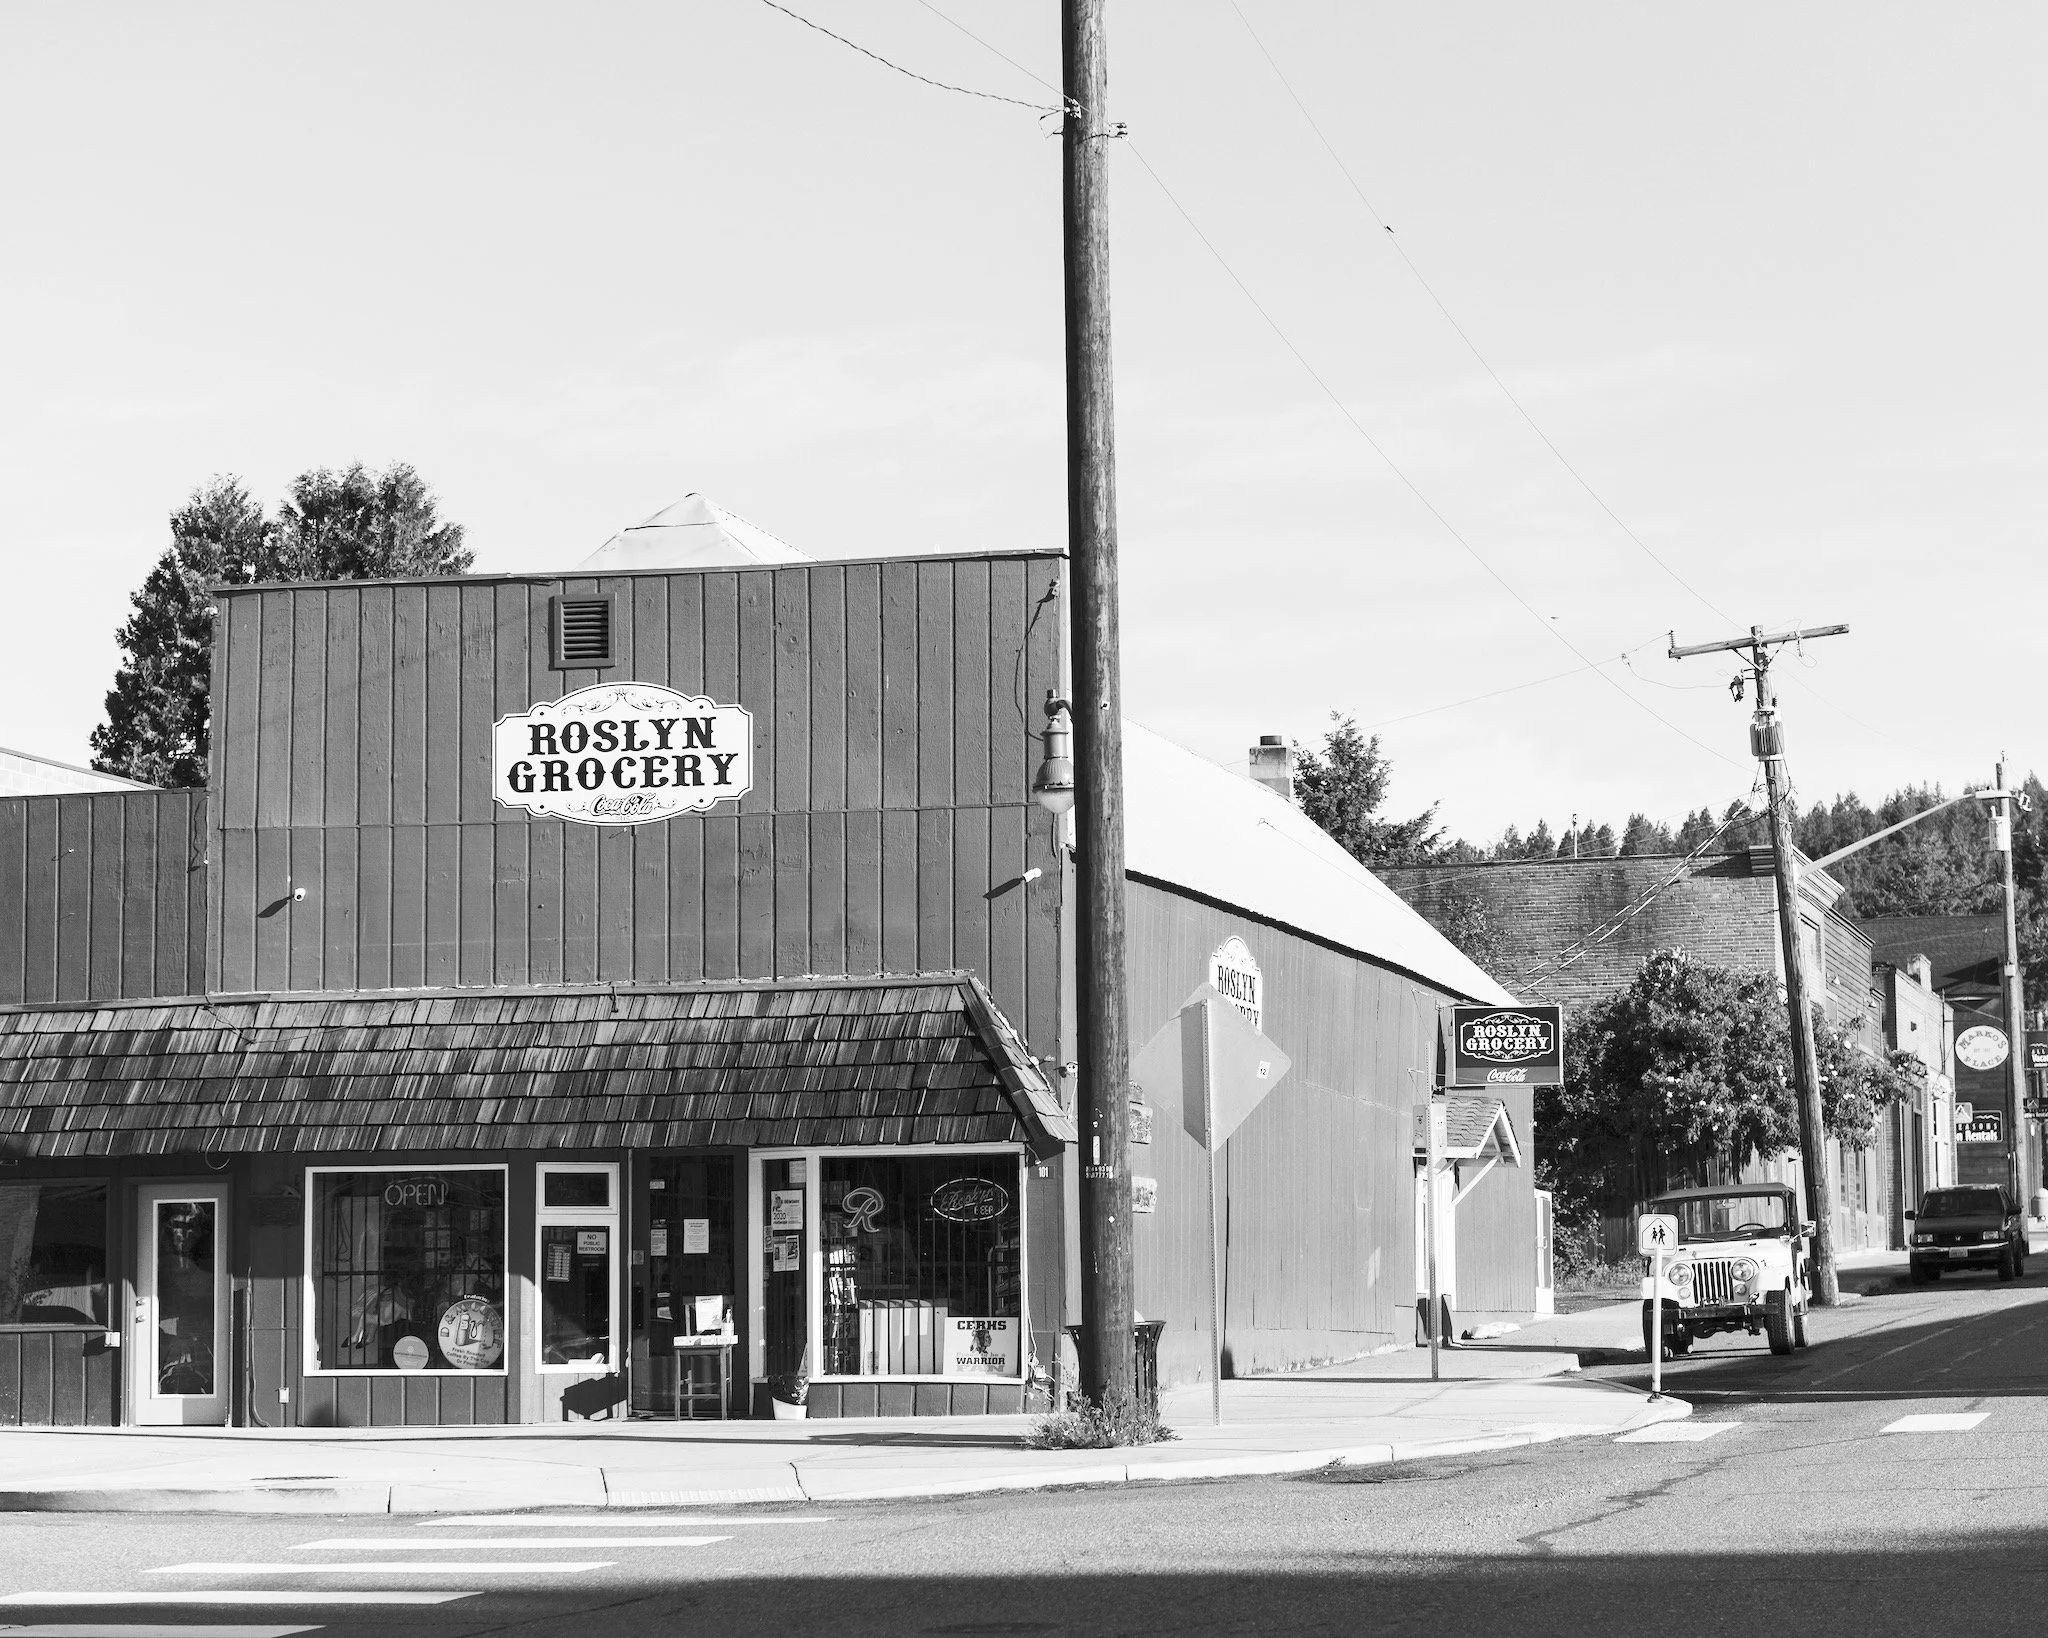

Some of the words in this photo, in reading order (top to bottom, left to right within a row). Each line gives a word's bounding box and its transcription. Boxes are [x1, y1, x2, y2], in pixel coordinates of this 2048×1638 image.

[527, 716, 717, 756] ROSLYN
[507, 753, 739, 793] GROCERY
[1217, 964, 1256, 1005] ROSLYN
[1472, 1024, 1541, 1038] ROSLYN
[1465, 1036, 1550, 1051] GROCERY
[1964, 1054, 2002, 1067] PLACE
[1958, 1122, 1998, 1131] EASONS
[1965, 1129, 1998, 1142] Rentals
[1038, 1166, 1049, 1178] 101
[384, 1183, 445, 1206] OPEN
[841, 1186, 884, 1233] R
[440, 1327, 450, 1337] D
[445, 1314, 456, 1325] &
[957, 1320, 1007, 1331] CERHS
[446, 1351, 462, 1359] Coffee
[466, 1350, 486, 1358] Roasted
[956, 1357, 1006, 1365] WARRIOR
